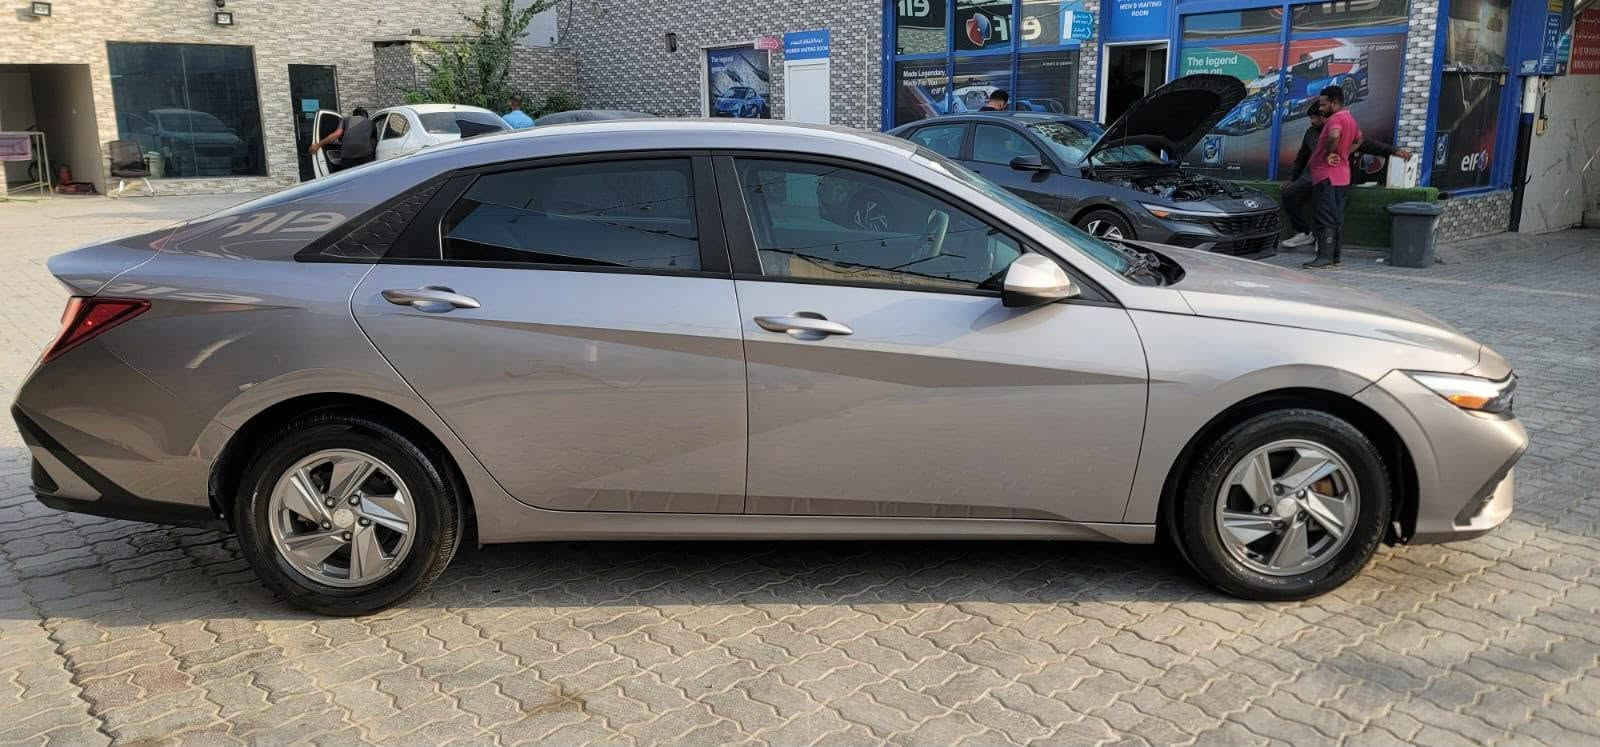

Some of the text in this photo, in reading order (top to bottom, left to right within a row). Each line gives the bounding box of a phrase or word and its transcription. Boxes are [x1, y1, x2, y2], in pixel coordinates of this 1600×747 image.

[1186, 55, 1239, 68] The legend
[1460, 153, 1480, 172] elf
